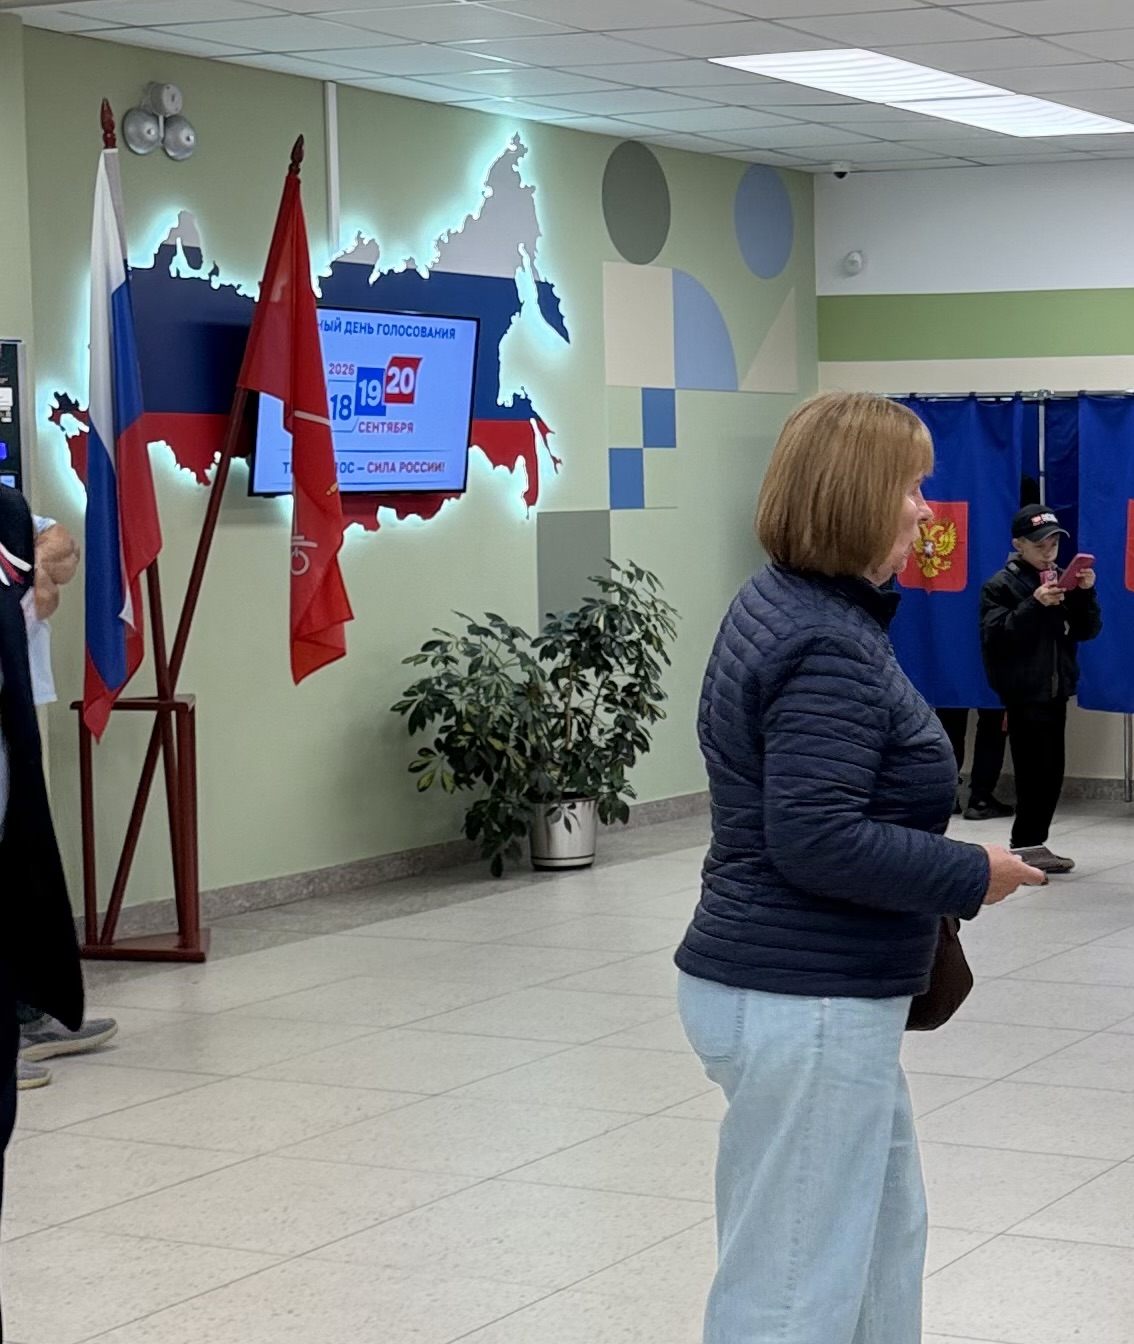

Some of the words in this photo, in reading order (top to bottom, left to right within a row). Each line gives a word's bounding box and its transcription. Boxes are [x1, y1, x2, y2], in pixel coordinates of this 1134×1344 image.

[344, 321, 375, 336] ДЕНЬ
[376, 322, 456, 340] ГОЛОСОВАНИЯ
[328, 363, 355, 376] 2026
[330, 394, 353, 421] 18
[358, 379, 382, 407] 19
[386, 366, 415, 395] 20
[358, 421, 414, 434] СЕНТЯБРЯ
[367, 461, 397, 474] СИЛА
[399, 461, 446, 474] РОССИИ!
